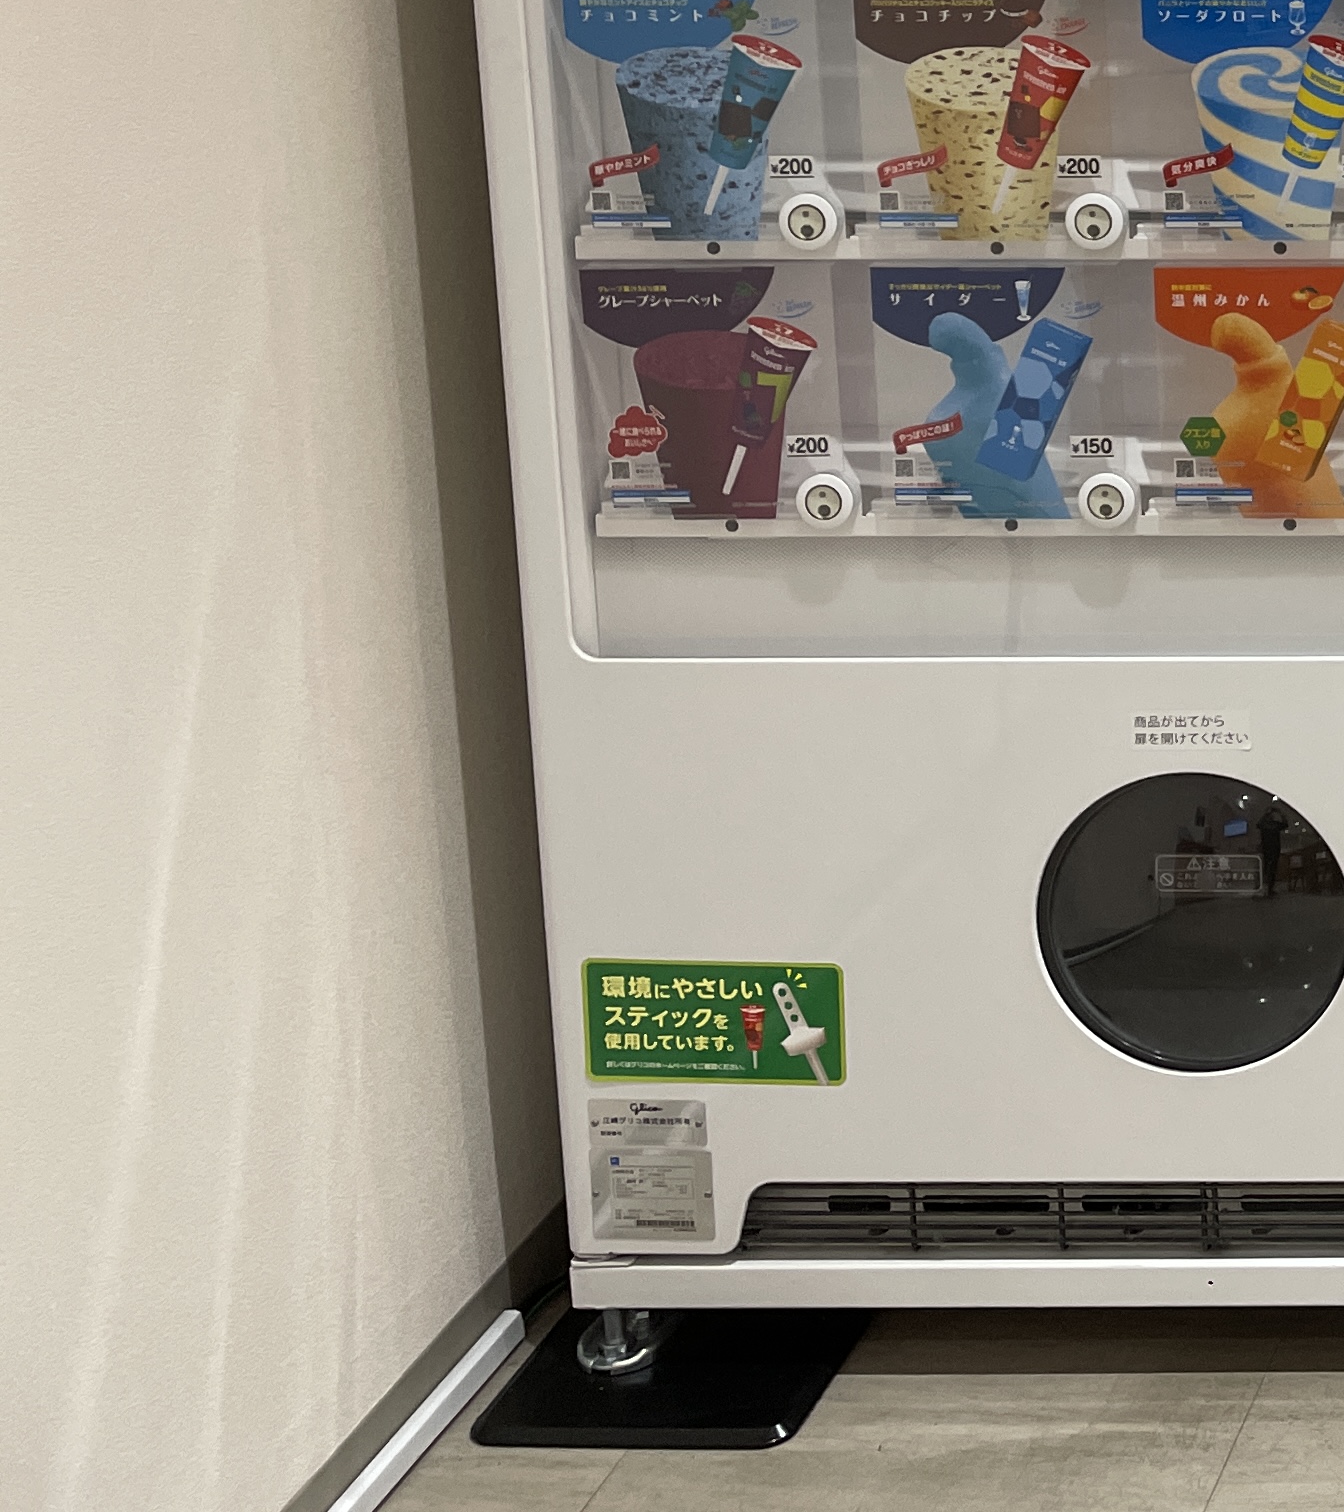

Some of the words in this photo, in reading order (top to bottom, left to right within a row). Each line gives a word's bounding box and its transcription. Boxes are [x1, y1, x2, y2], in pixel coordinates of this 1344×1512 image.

[579, 9, 704, 23] チョコミント
[870, 9, 996, 23] チョコチップ
[1158, 8, 1282, 23] ソーダフロート
[770, 158, 812, 175] ¥200
[1058, 157, 1100, 175] ¥200
[598, 294, 722, 308] グレープシャーベット
[889, 294, 1006, 306] サイダー
[787, 437, 829, 454] ¥200
[1072, 437, 1113, 455] ¥150
[1134, 715, 1224, 728] 商品が出てから
[1135, 733, 1248, 745] 扉を開けてください
[601, 976, 763, 1000] 環境にやさしい
[605, 1007, 728, 1030] スティックを
[605, 1033, 734, 1052] 使用しています。
